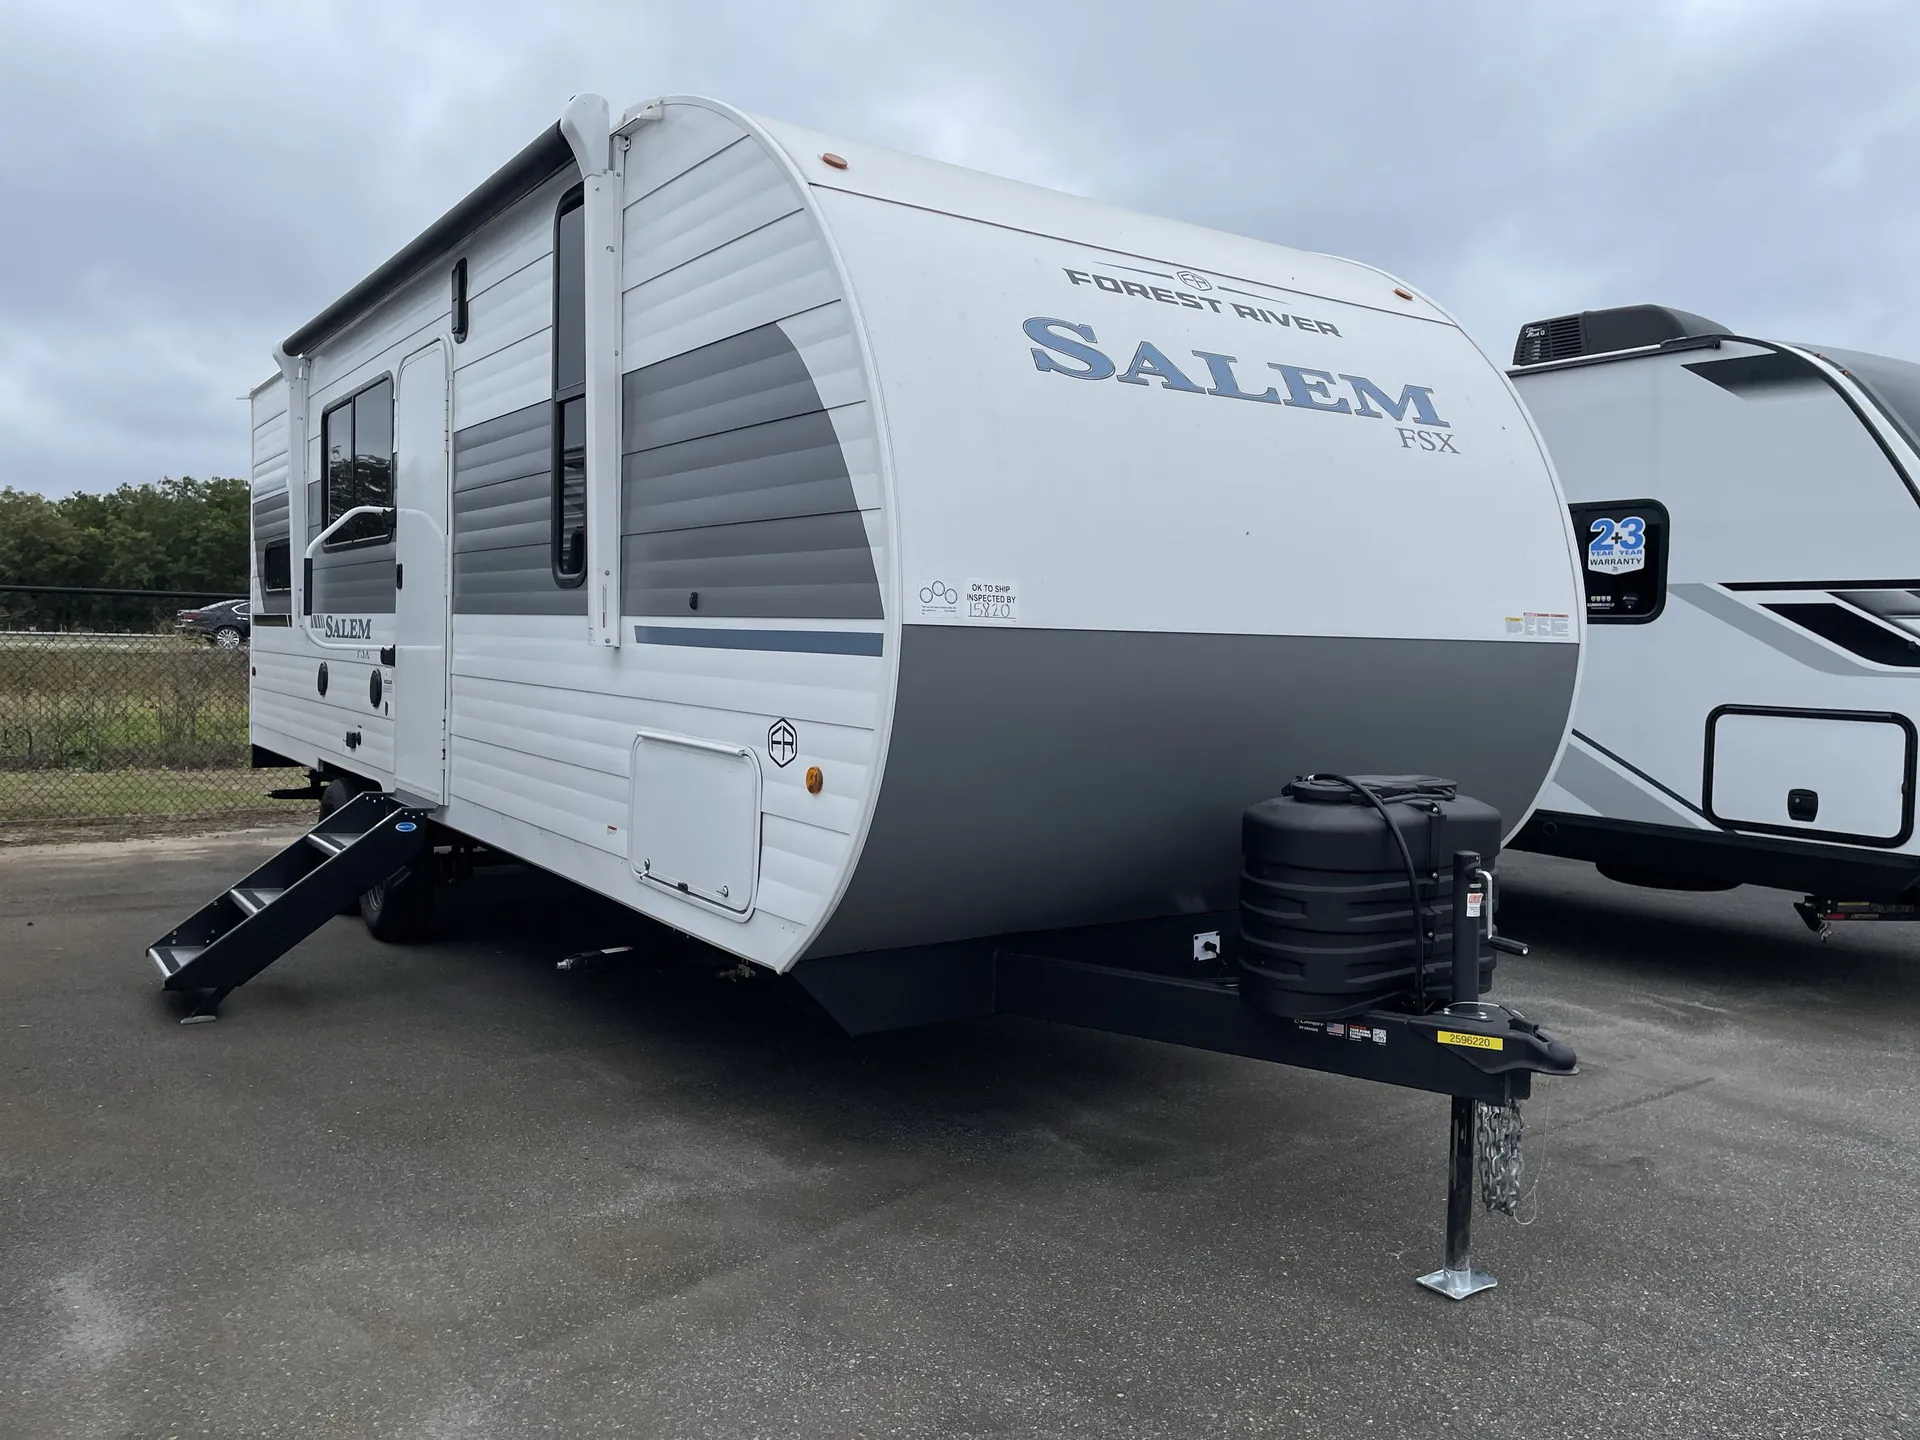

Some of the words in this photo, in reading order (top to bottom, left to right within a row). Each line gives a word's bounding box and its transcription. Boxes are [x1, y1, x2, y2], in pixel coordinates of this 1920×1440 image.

[1062, 267, 1222, 314] FOREST
[1229, 302, 1344, 338] RIVER
[1021, 315, 1452, 428] SALEM
[1394, 427, 1462, 455] FSX
[1590, 558, 1642, 566] WARRANTY
[971, 583, 982, 592] OK
[984, 584, 993, 592] TO
[994, 585, 1011, 593] SHIP
[966, 593, 1005, 603] INSPECTED
[1006, 595, 1016, 604] BY
[969, 601, 1011, 618] 15820
[325, 614, 372, 639] SALEM
[1449, 1033, 1491, 1047] 2596220
